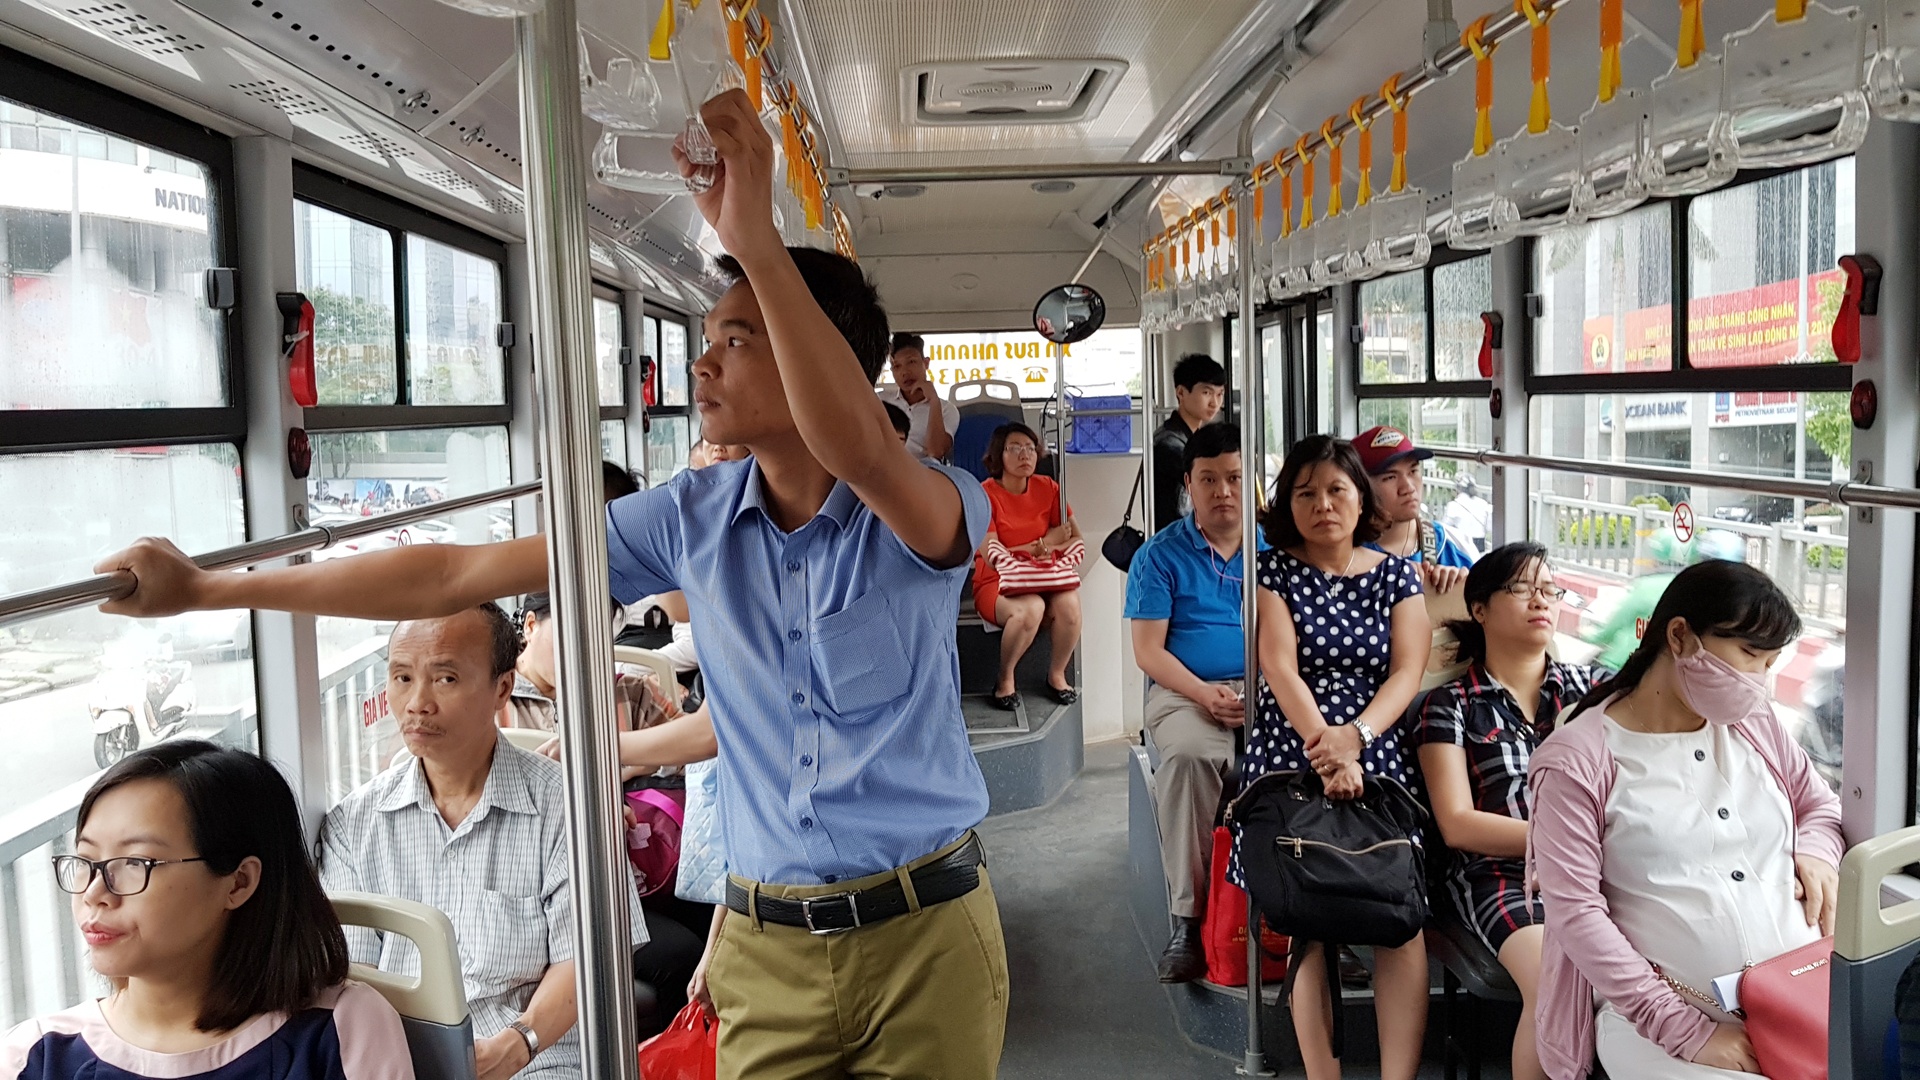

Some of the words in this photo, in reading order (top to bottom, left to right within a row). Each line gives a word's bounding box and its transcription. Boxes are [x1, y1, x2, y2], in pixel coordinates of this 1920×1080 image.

[1749, 329, 1763, 347] LAO
[1657, 400, 1687, 416] BANK
[363, 690, 378, 728] GIÁ
